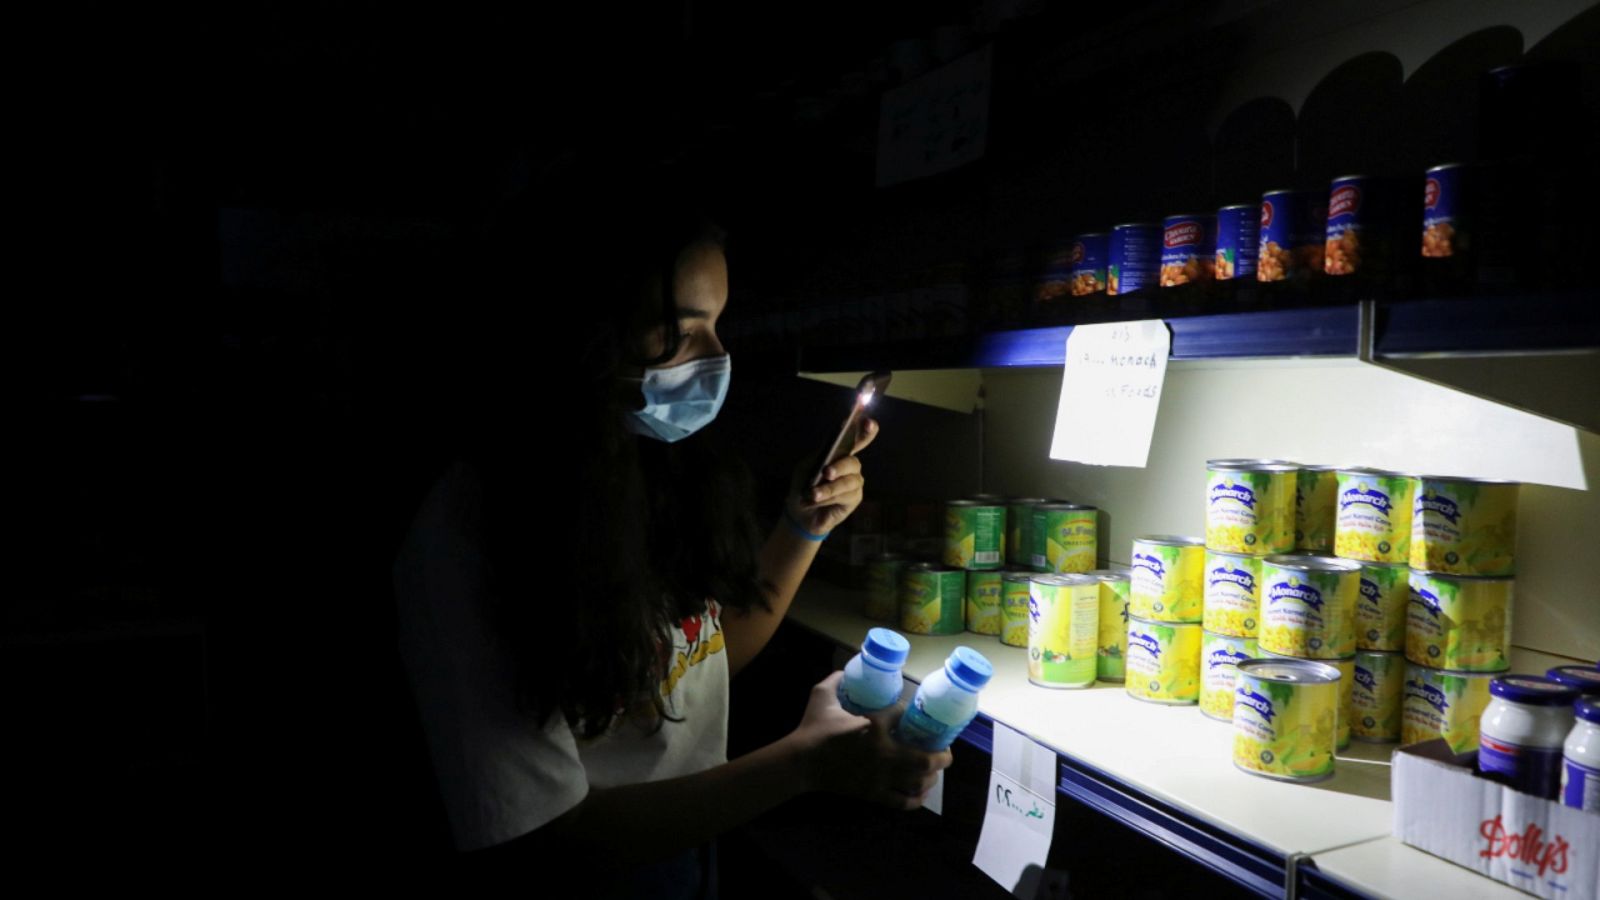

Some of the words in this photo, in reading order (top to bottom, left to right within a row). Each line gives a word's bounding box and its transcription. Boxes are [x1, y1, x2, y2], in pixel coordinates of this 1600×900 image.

[1342, 491, 1388, 509] Monarch
[1210, 571, 1252, 587] Monarch
[1271, 585, 1319, 604] Monarch
[1479, 813, 1569, 878] Dolly's
